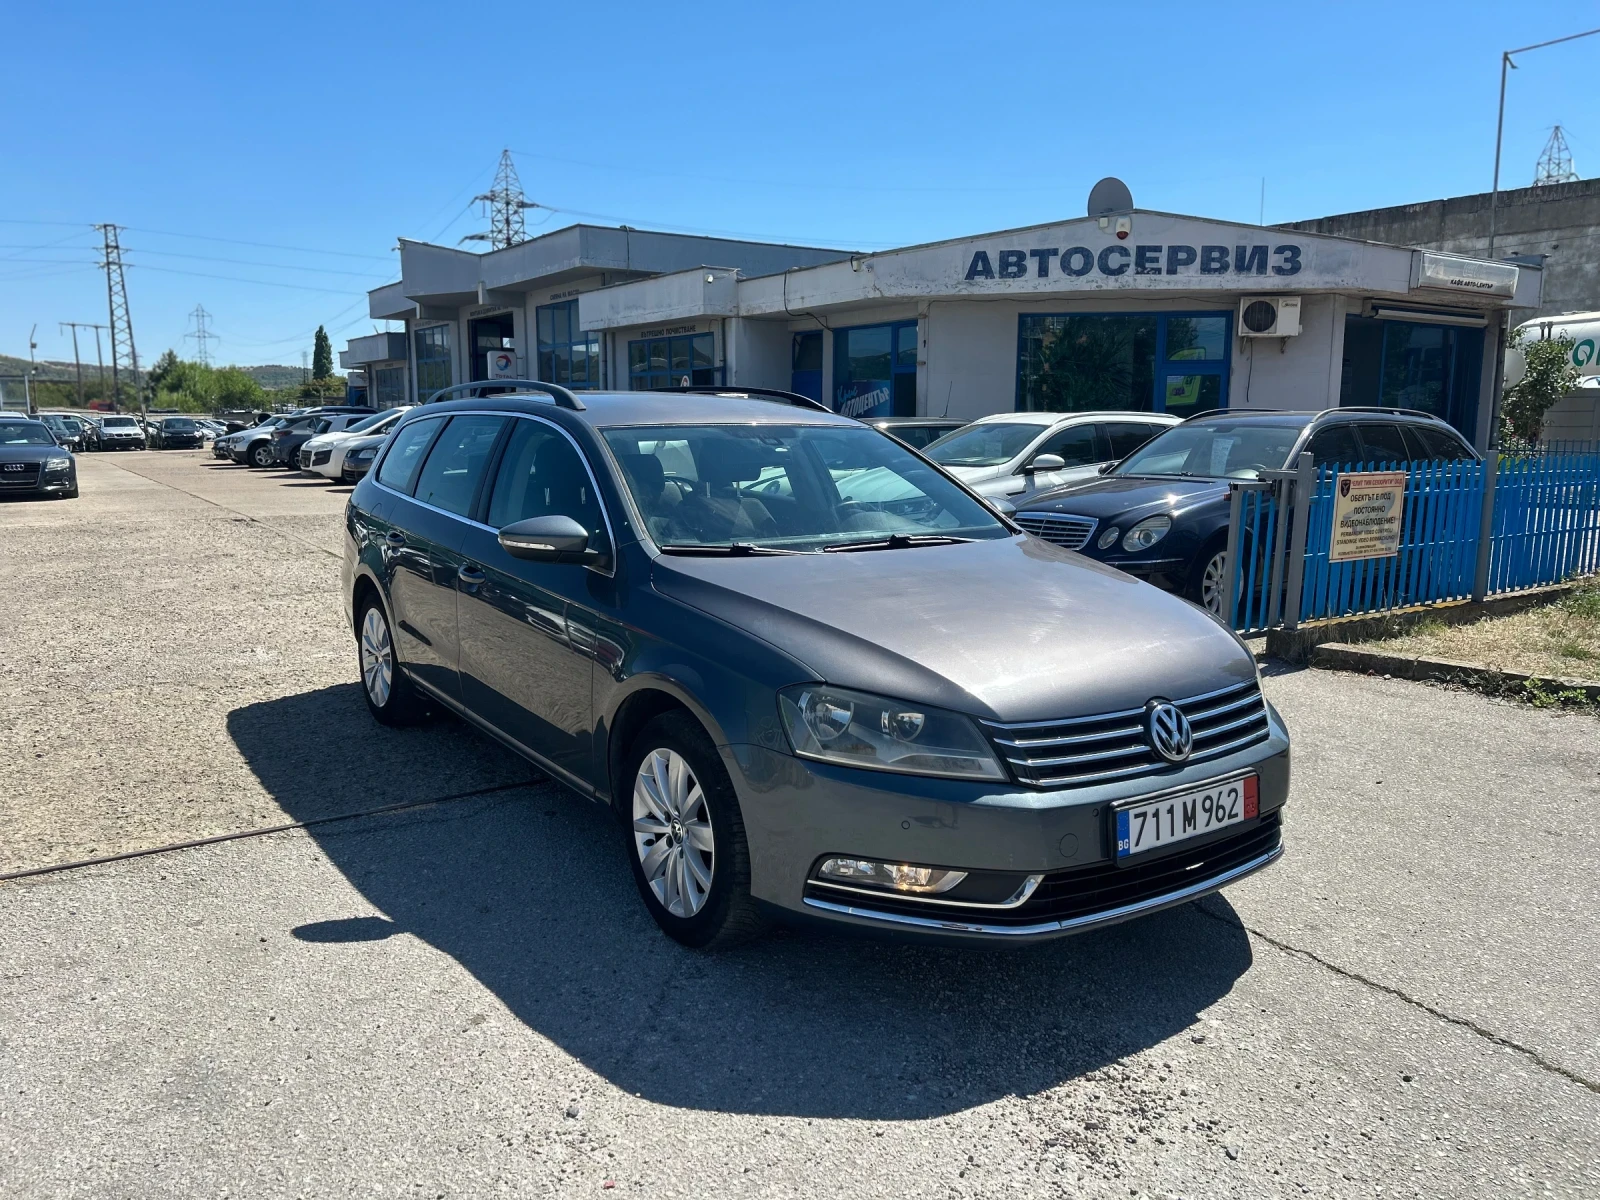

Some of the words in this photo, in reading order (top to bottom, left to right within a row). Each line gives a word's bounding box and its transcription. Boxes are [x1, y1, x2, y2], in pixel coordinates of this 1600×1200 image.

[964, 244, 1302, 281] АВТОСЕРВИЗ
[665, 324, 696, 336] ПОЧИСТВАНЕ
[1351, 494, 1375, 502] ОБЕКТЪТ
[1376, 493, 1380, 501] Е
[1380, 493, 1391, 501] ПОД
[1354, 506, 1386, 515] ПОСТОЯННО
[1340, 517, 1396, 528] ВИДЕОНАБЛЮДЕНИЕ!
[1118, 838, 1129, 851] BG
